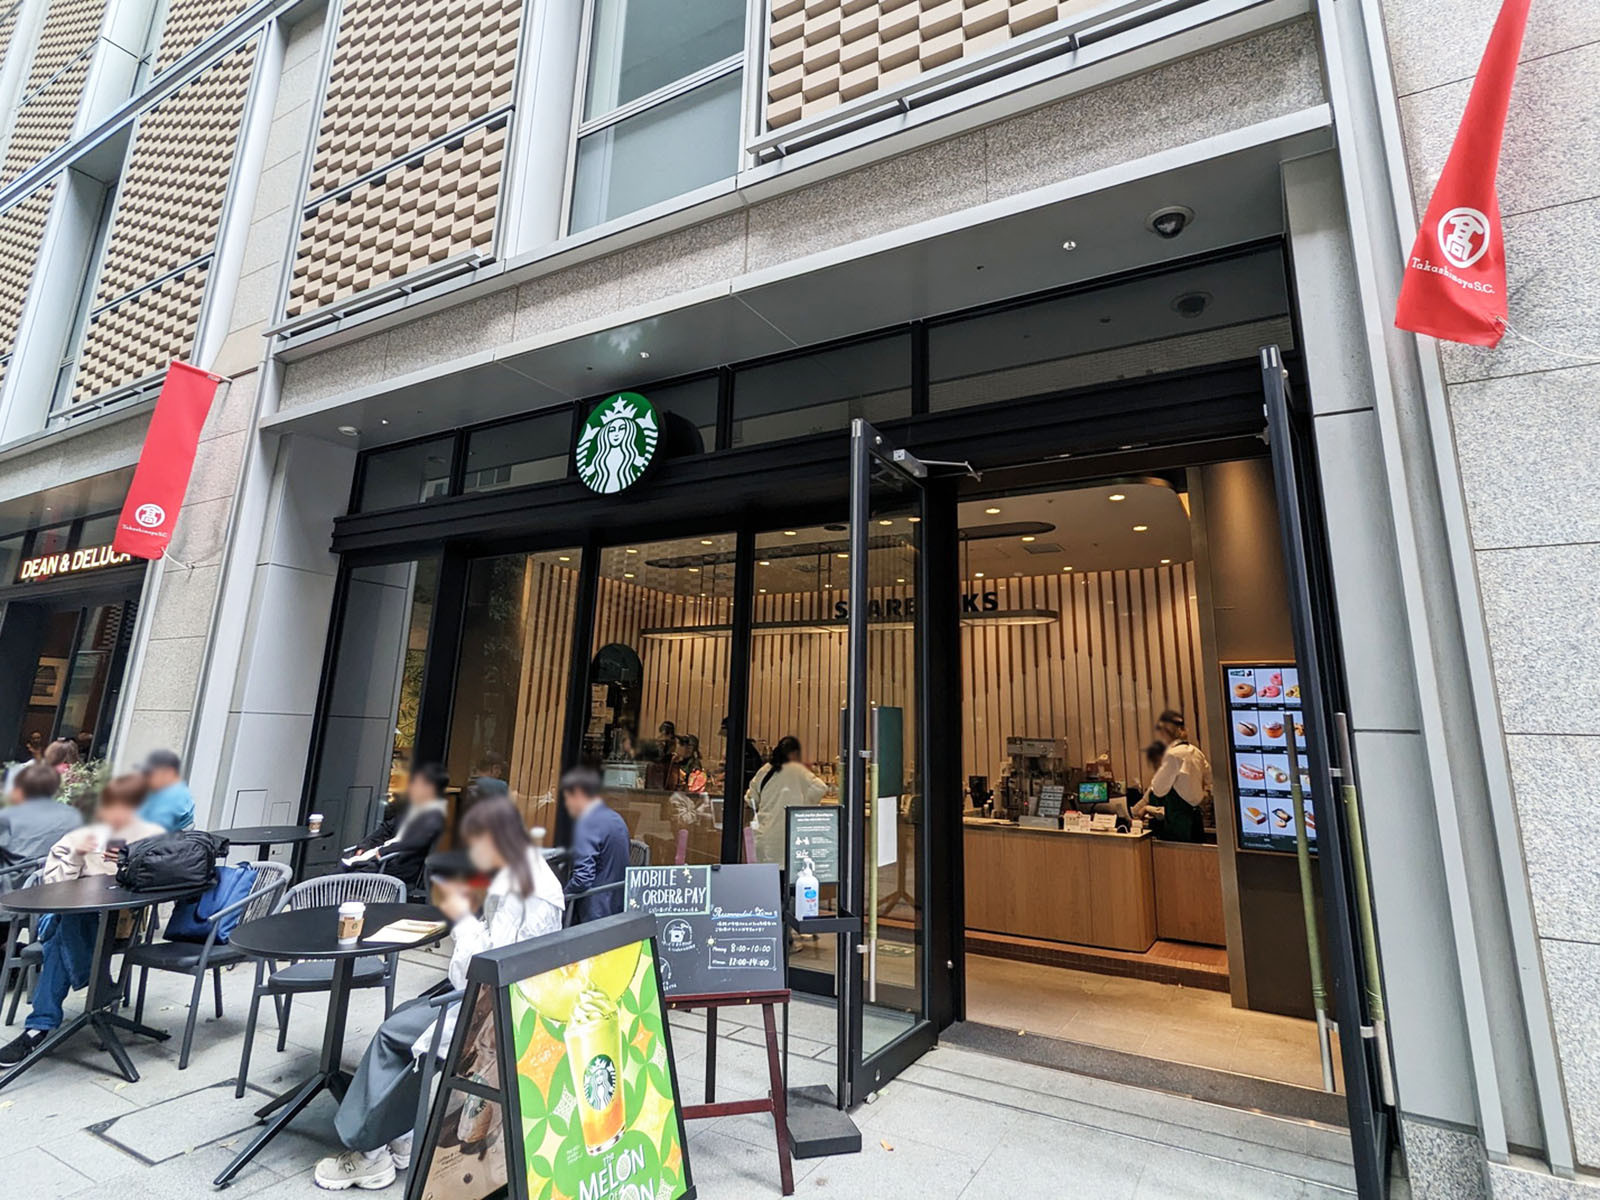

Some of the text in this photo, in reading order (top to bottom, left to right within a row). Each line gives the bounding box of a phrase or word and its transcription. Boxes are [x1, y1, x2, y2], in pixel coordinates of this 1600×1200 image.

[20, 557, 58, 579] DEAN
[59, 553, 70, 573] &
[630, 869, 677, 888] MOBILE
[579, 1144, 646, 1200] MELON
